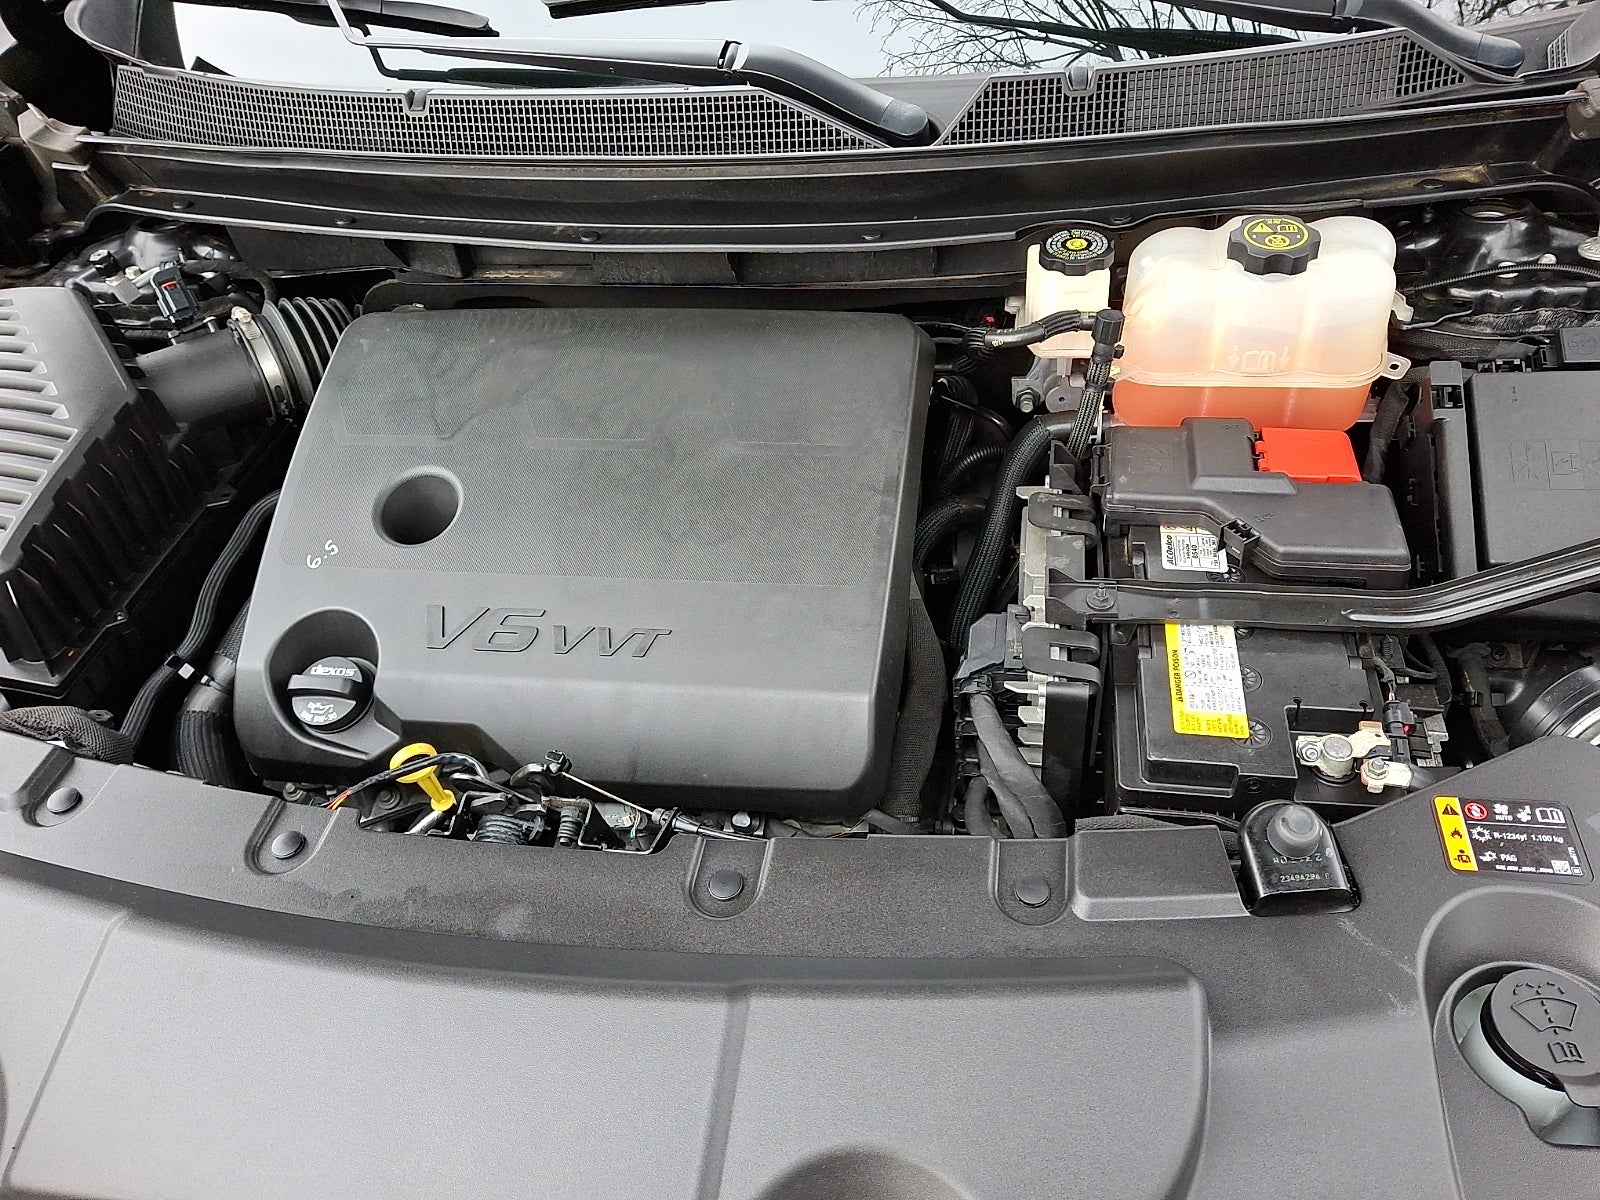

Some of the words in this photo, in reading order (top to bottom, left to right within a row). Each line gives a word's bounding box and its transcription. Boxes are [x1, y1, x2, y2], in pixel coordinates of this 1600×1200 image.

[425, 604, 546, 653] V6
[552, 625, 672, 658] VVT
[1172, 649, 1180, 671] POISON
[310, 664, 357, 677] dexos
[1174, 672, 1183, 697] DANGER
[1495, 814, 1513, 822] AUTO
[1530, 834, 1553, 843] 1.100
